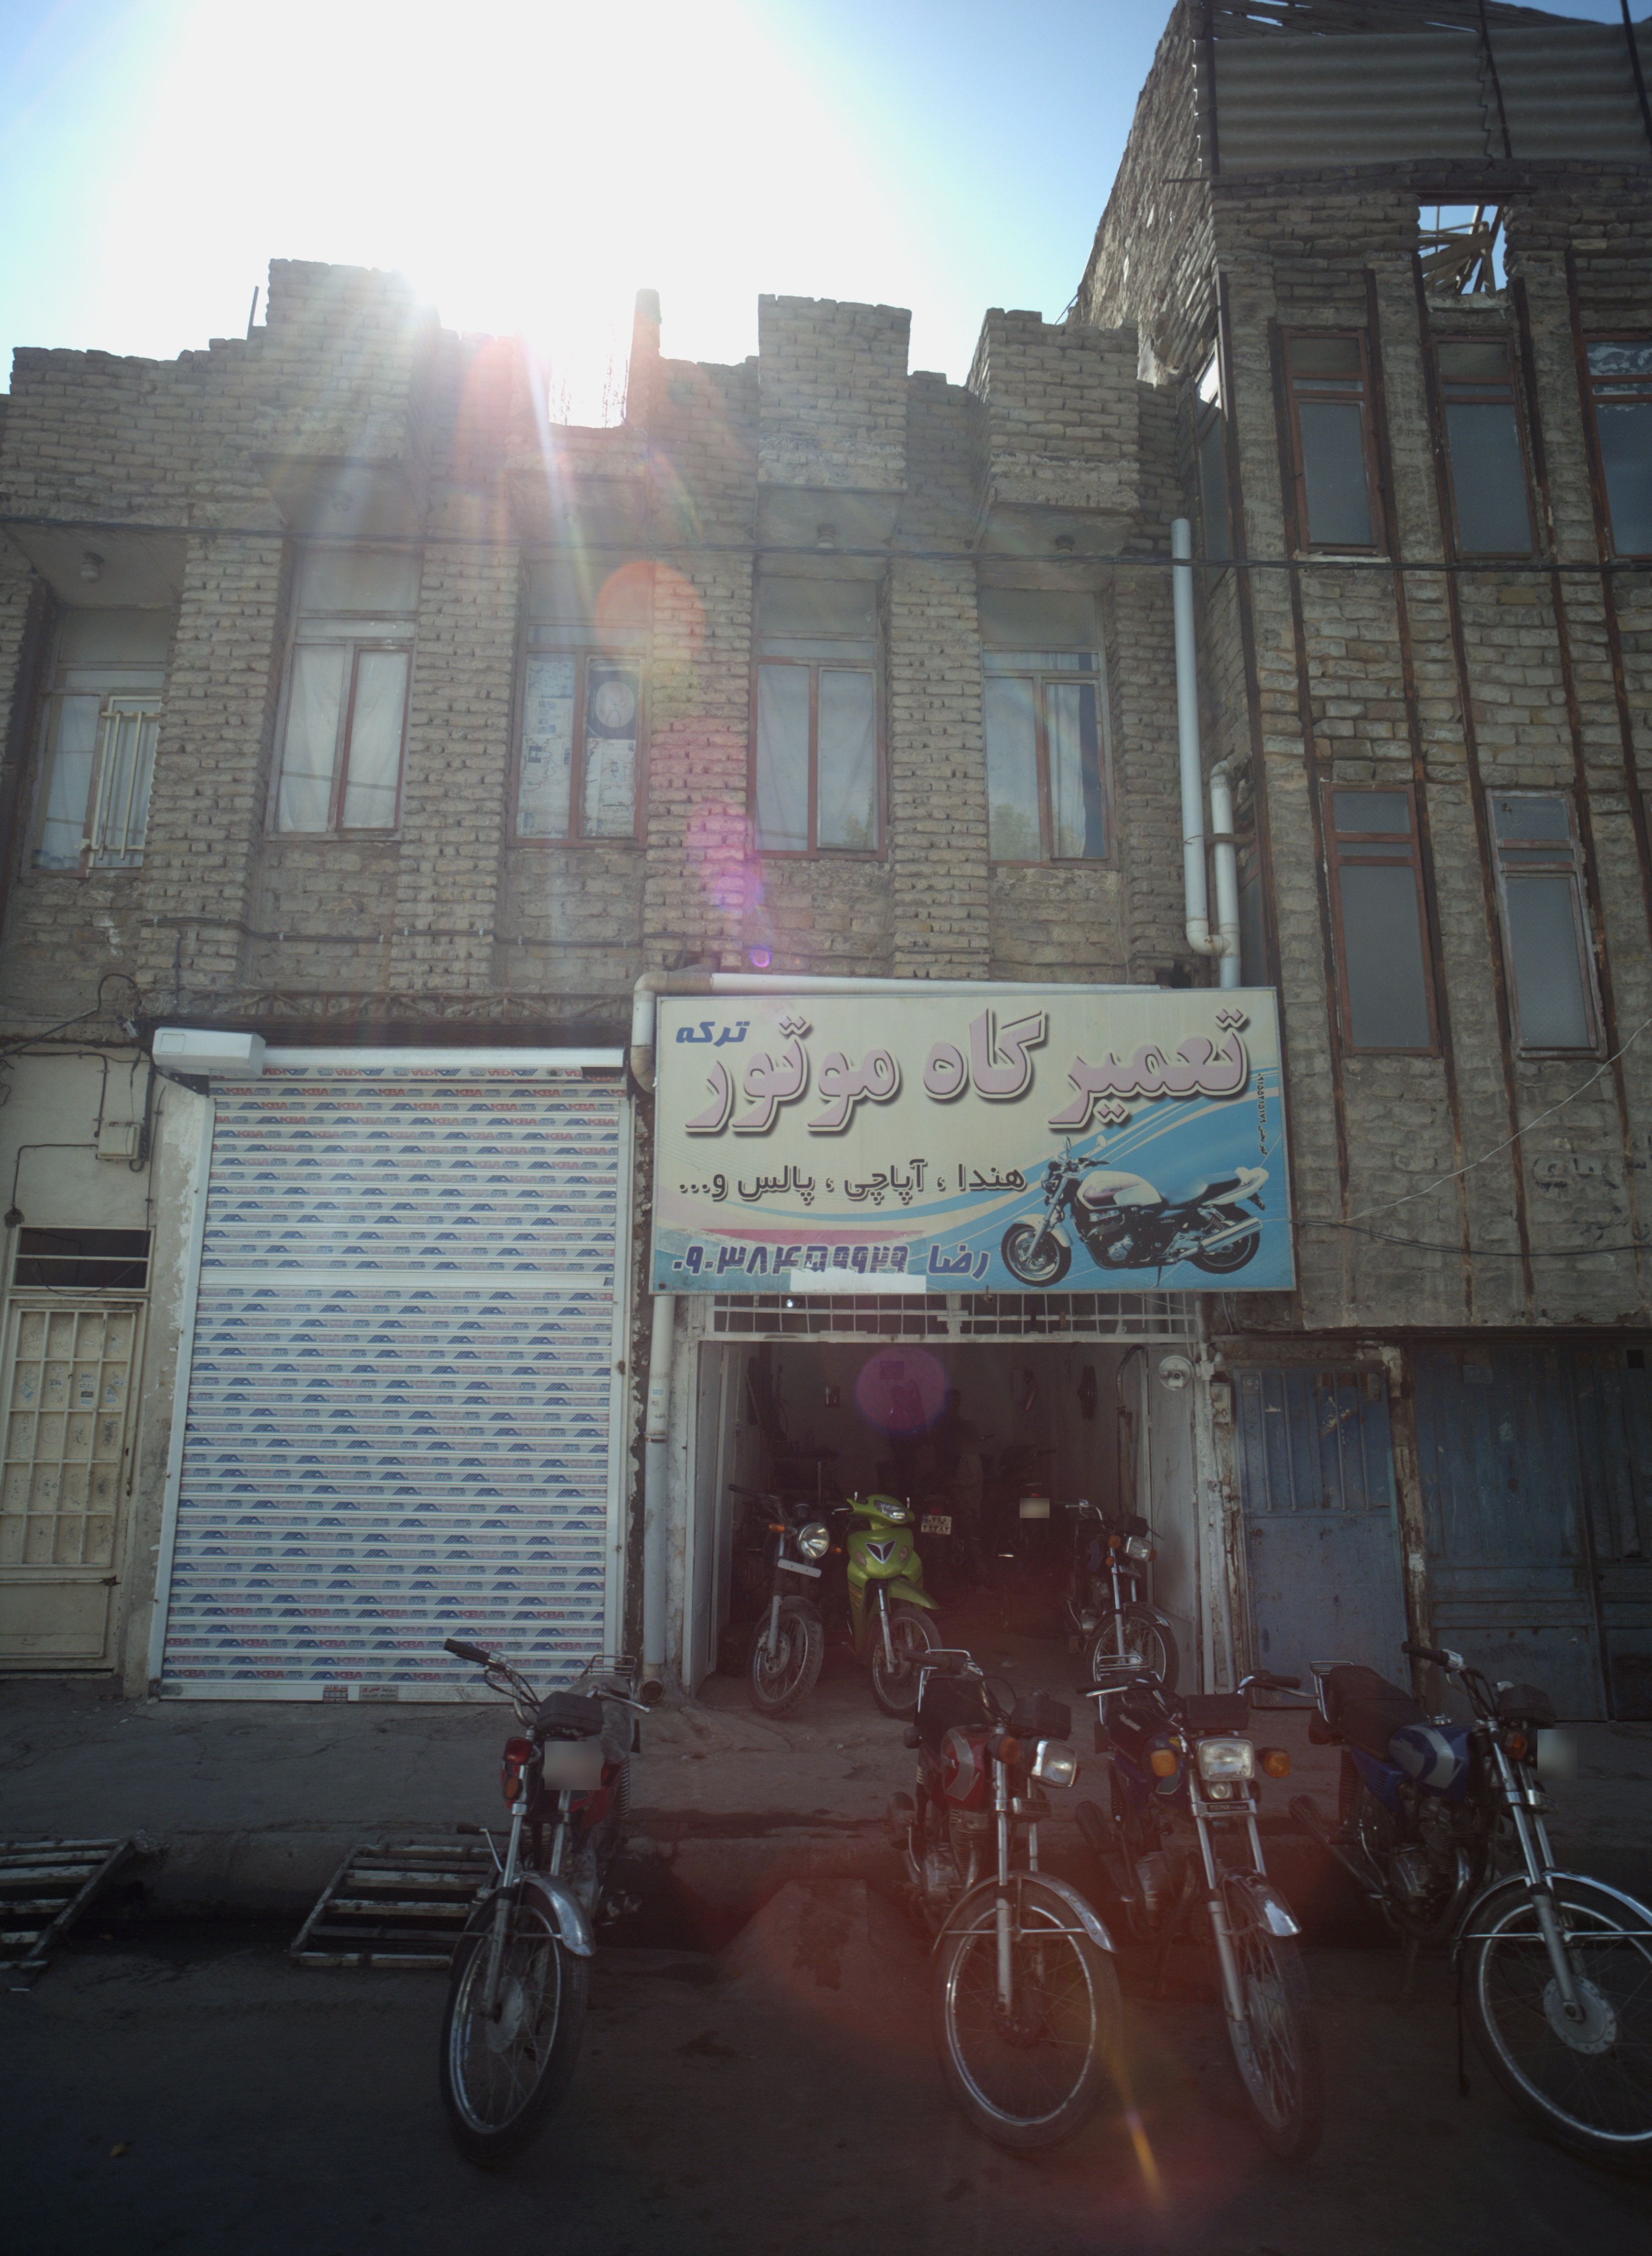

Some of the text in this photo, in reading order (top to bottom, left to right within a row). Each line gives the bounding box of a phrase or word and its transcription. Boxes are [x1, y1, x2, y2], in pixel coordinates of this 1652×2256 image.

[676, 1021, 750, 1046] ترکه
[684, 1015, 901, 1132] موتور
[737, 1165, 815, 1205] پالس
[844, 1159, 928, 1205] آپاچی
[959, 1163, 1028, 1192] هندا
[928, 1244, 991, 1282] رضا
